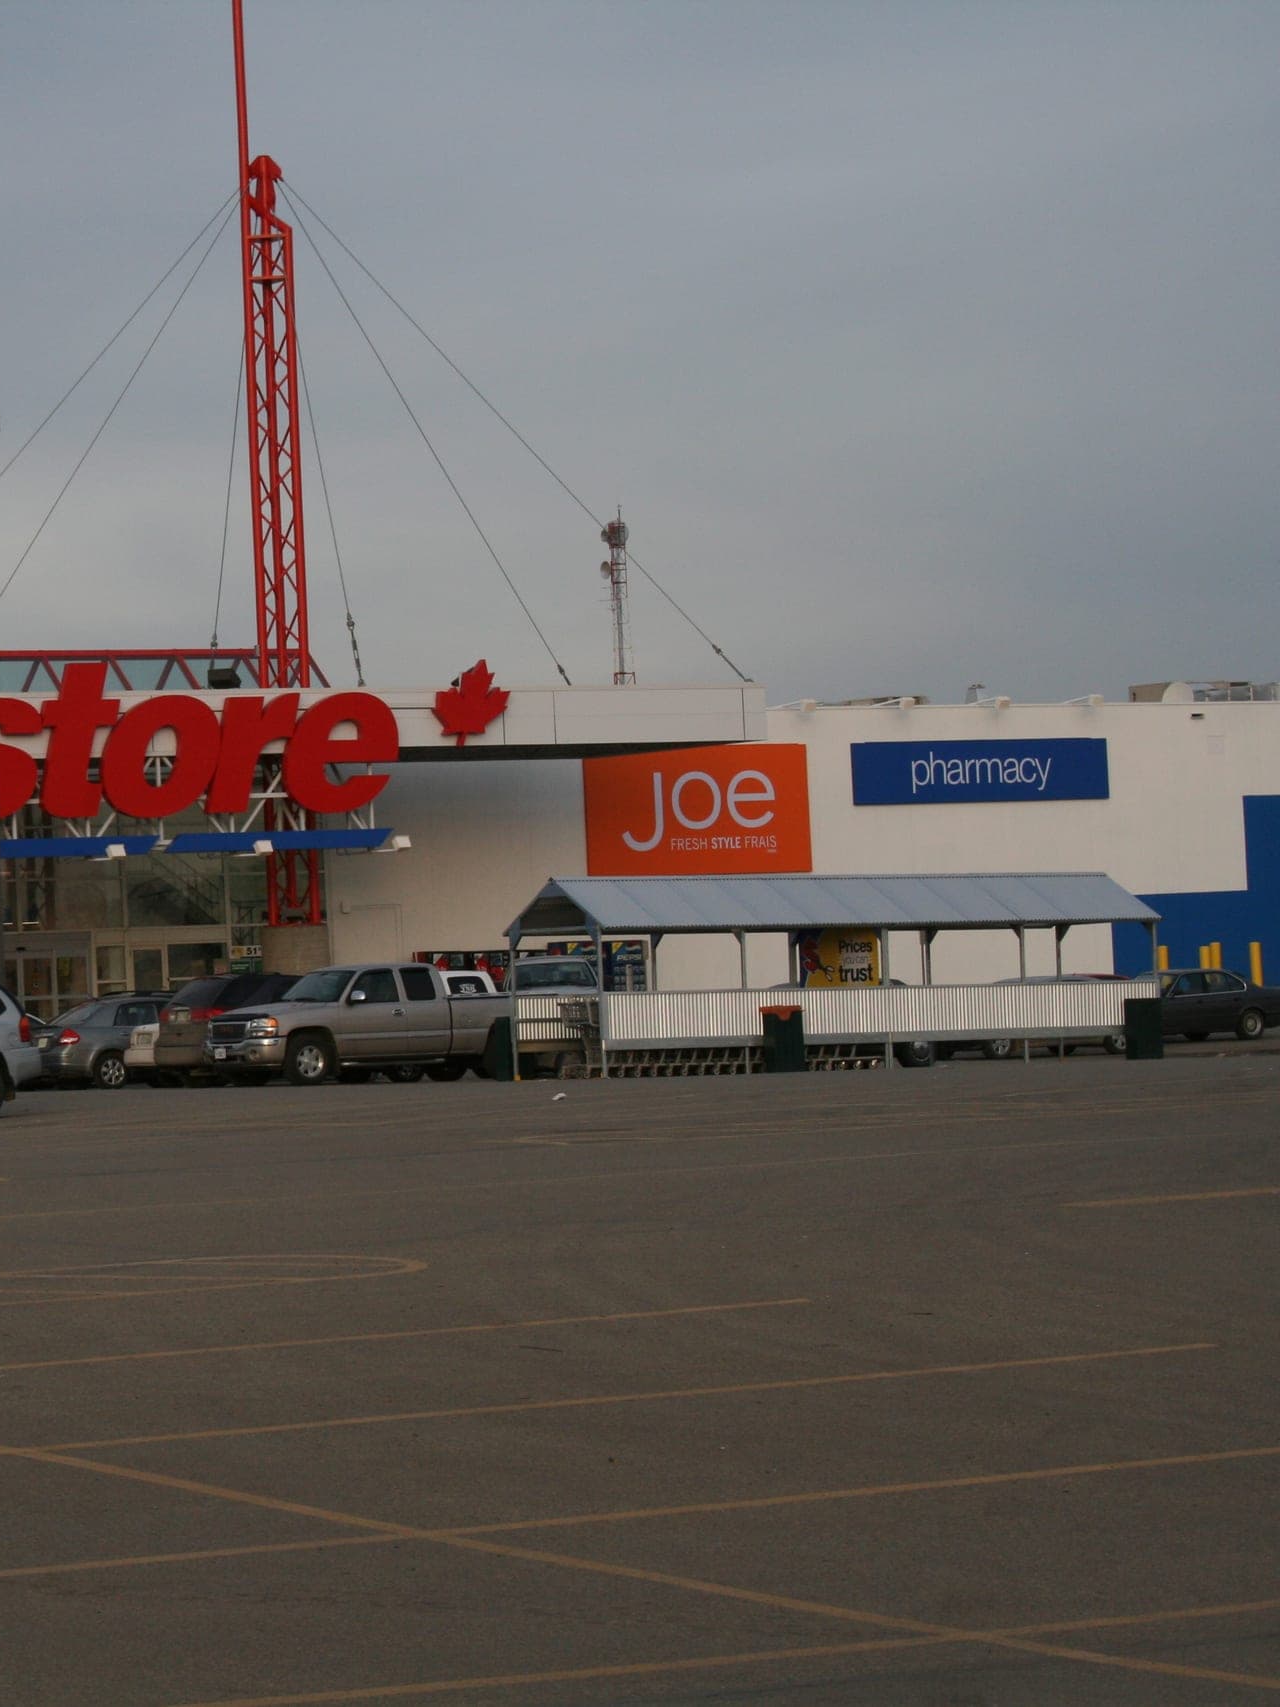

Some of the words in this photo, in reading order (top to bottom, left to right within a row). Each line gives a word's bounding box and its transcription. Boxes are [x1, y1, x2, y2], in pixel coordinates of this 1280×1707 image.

[911, 751, 1052, 794] pharmacy
[670, 838, 708, 851] FRESH
[710, 836, 742, 849] STYLE
[744, 835, 777, 849] FRAIS
[839, 940, 872, 954] Prices
[616, 953, 642, 962] PEPSI
[839, 964, 873, 982] trust
